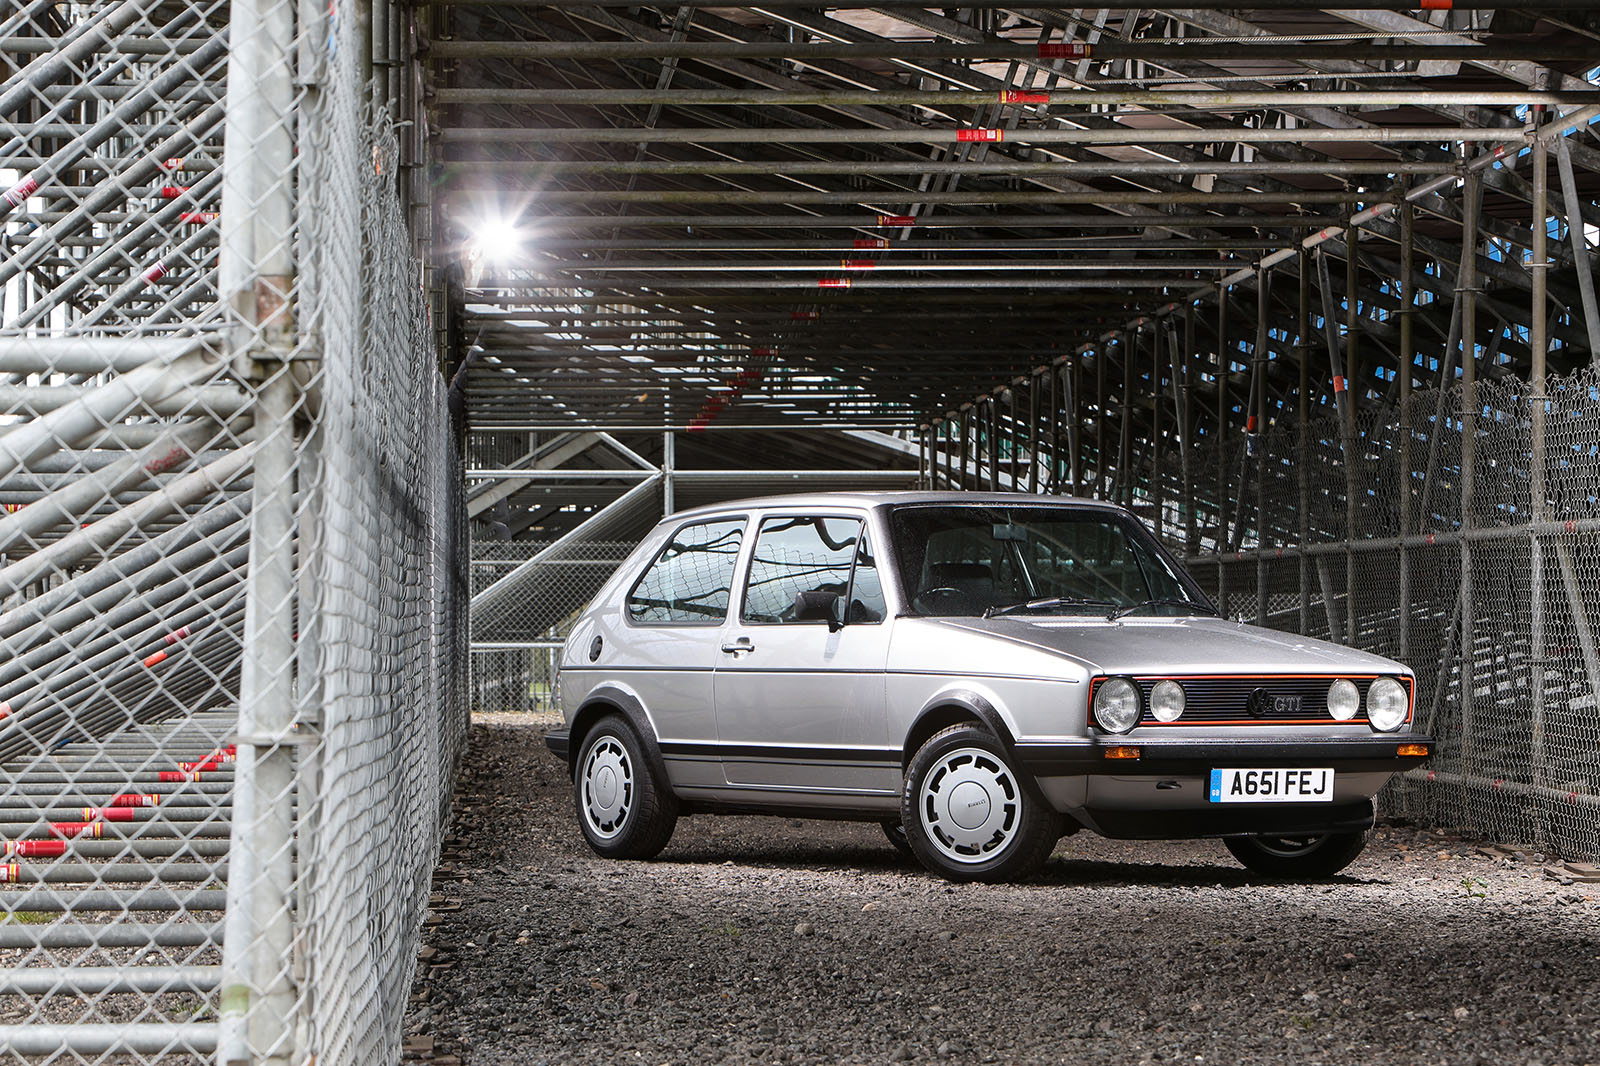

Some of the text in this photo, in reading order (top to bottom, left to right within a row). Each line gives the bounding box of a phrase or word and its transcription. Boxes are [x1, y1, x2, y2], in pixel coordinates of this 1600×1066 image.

[1274, 696, 1301, 712] GTI
[1231, 770, 1326, 795] A651 FEJ
